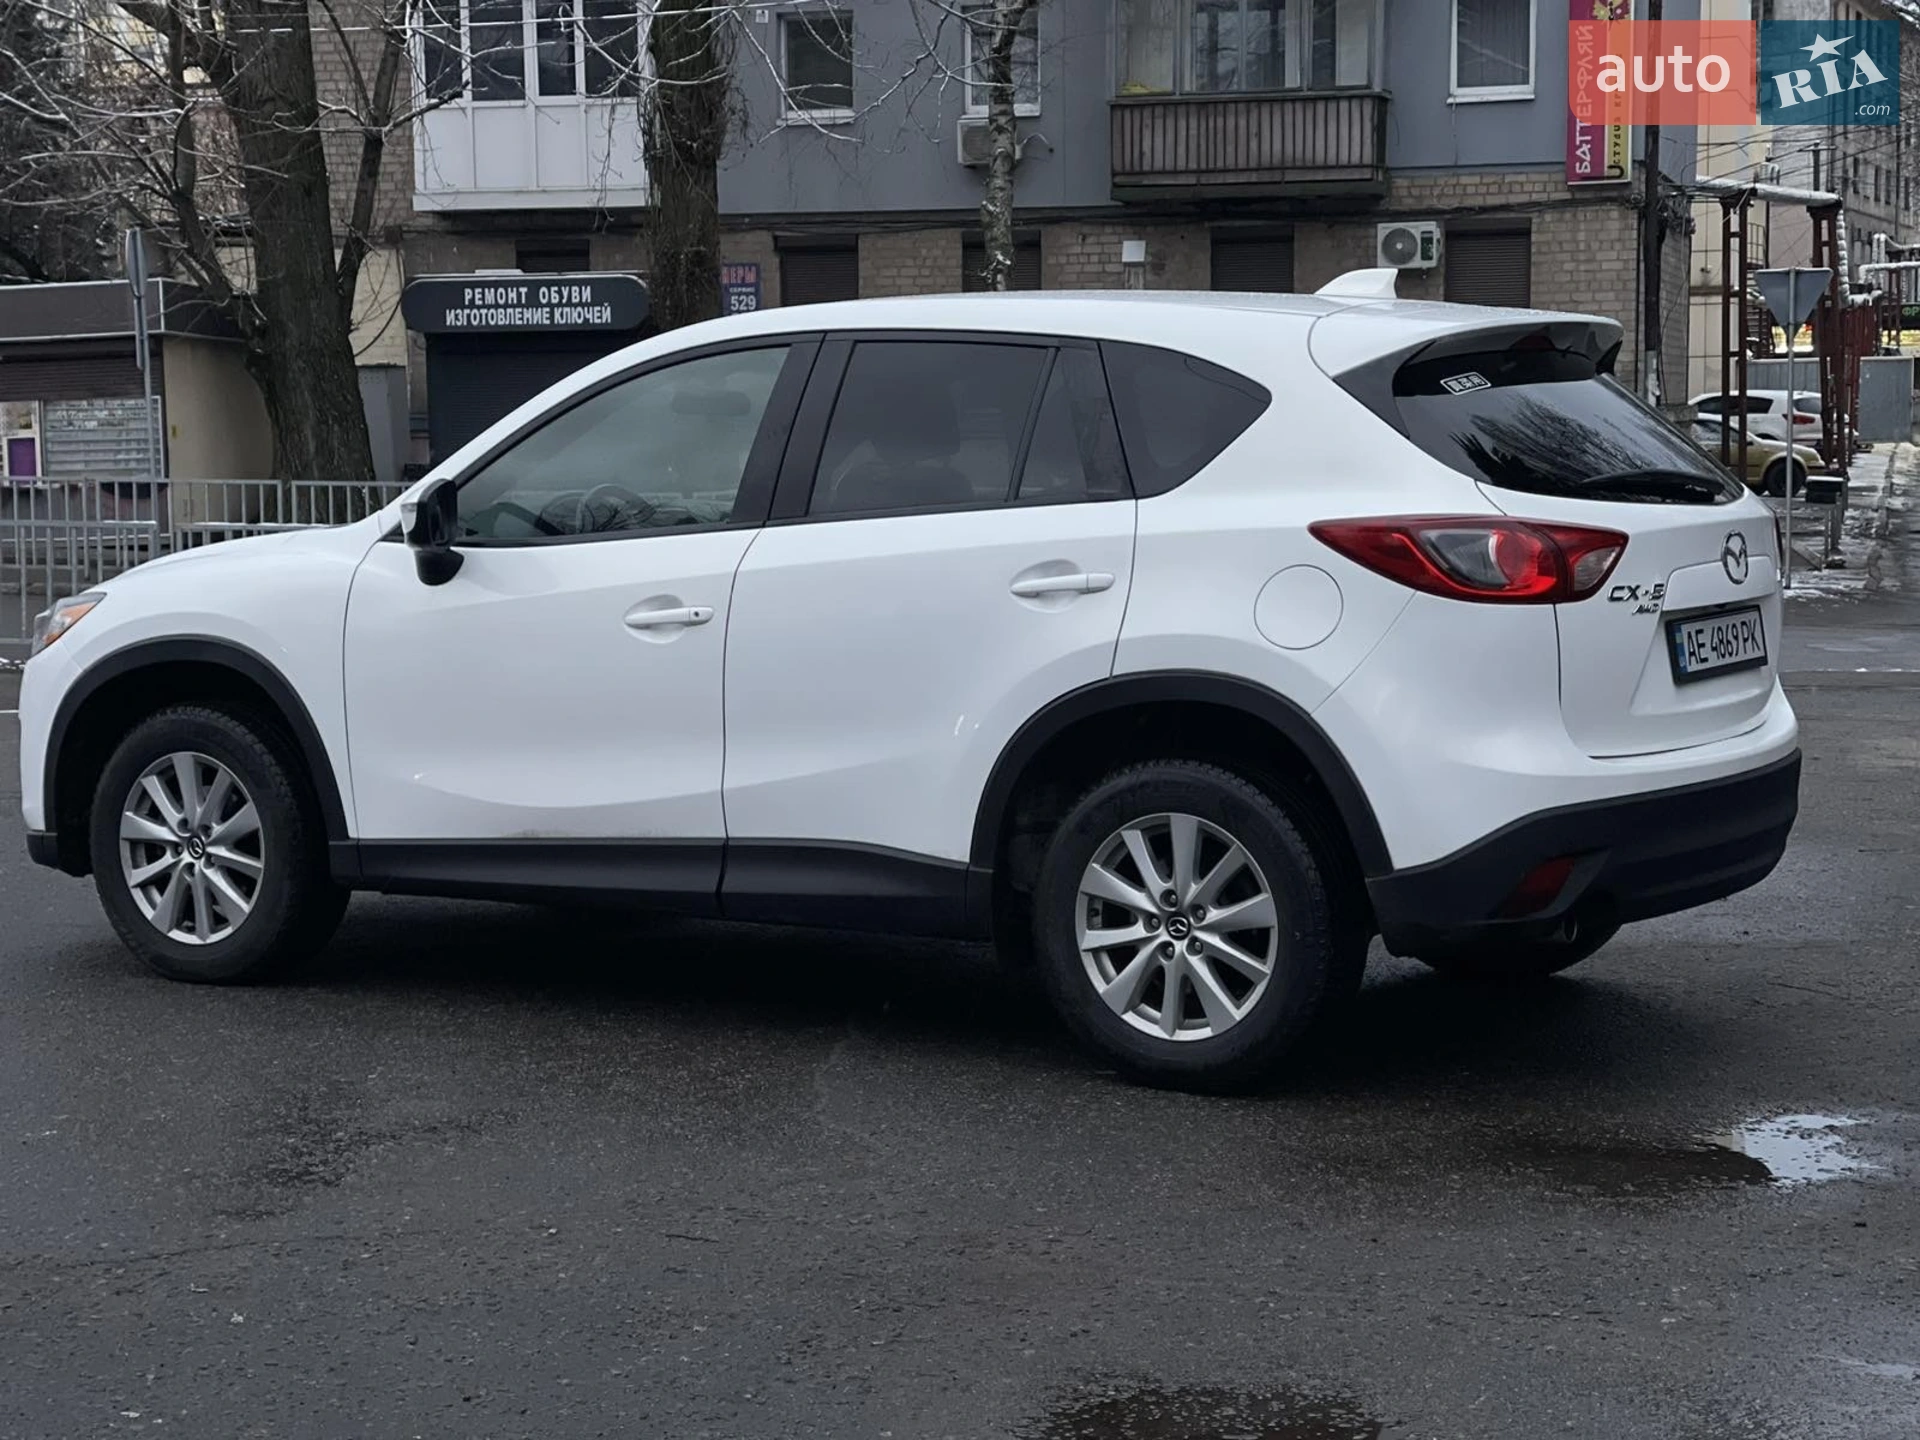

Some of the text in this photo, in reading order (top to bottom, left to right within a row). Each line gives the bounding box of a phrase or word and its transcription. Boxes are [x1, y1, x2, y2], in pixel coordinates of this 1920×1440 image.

[1575, 25, 1594, 174] БАТТЕРФЛЯЙ
[464, 285, 591, 306] РЕМОНТ ОБУВИ
[730, 295, 757, 311] 529
[445, 303, 612, 327] ИЗГОТОВЛЕНИЕ КЛЮЧЕЙ
[1608, 583, 1665, 602] CX-5
[1687, 618, 1760, 666] AE 4869 PK
